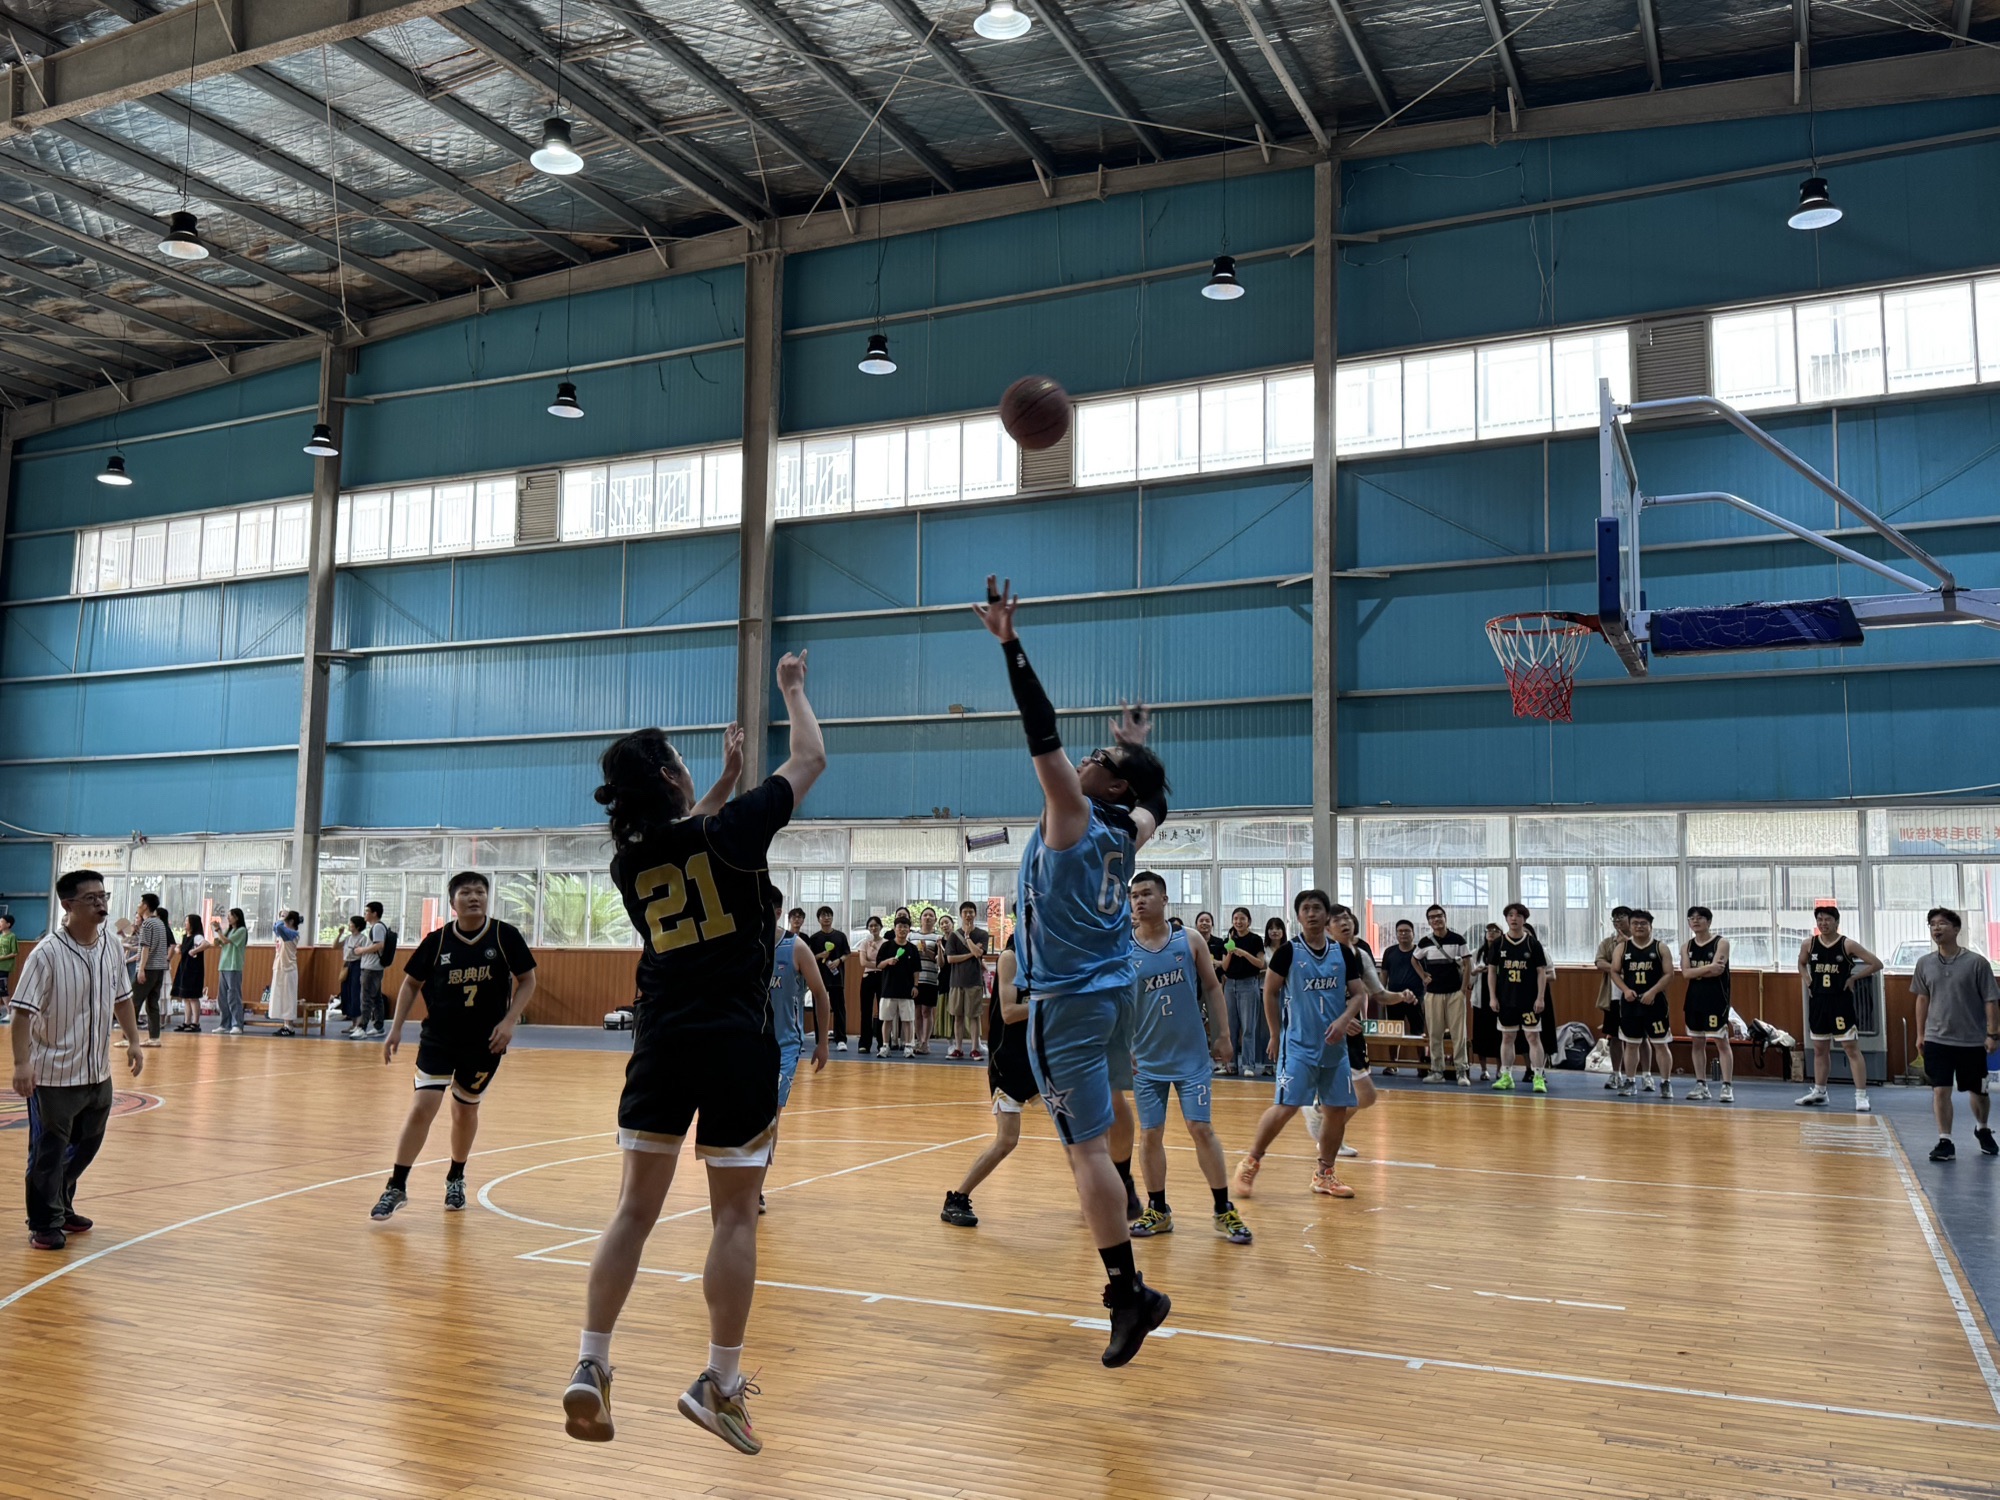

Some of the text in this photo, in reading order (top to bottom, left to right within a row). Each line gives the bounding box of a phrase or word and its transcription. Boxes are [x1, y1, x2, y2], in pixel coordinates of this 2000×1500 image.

[1097, 851, 1124, 916] 6
[634, 851, 737, 955] 21
[447, 965, 493, 985] 恩典队
[1143, 968, 1185, 993] X战队
[1303, 976, 1338, 992] X战队
[1508, 969, 1522, 983] 31
[1635, 971, 1647, 985] 11
[463, 985, 478, 1007] 7
[1160, 994, 1173, 1016] 2
[1319, 996, 1325, 1015] 1
[1522, 1011, 1538, 1025] 31
[1652, 1020, 1666, 1034] 11
[1835, 1016, 1846, 1030] 6
[470, 1071, 489, 1090] 7
[1197, 1084, 1208, 1106] 2
